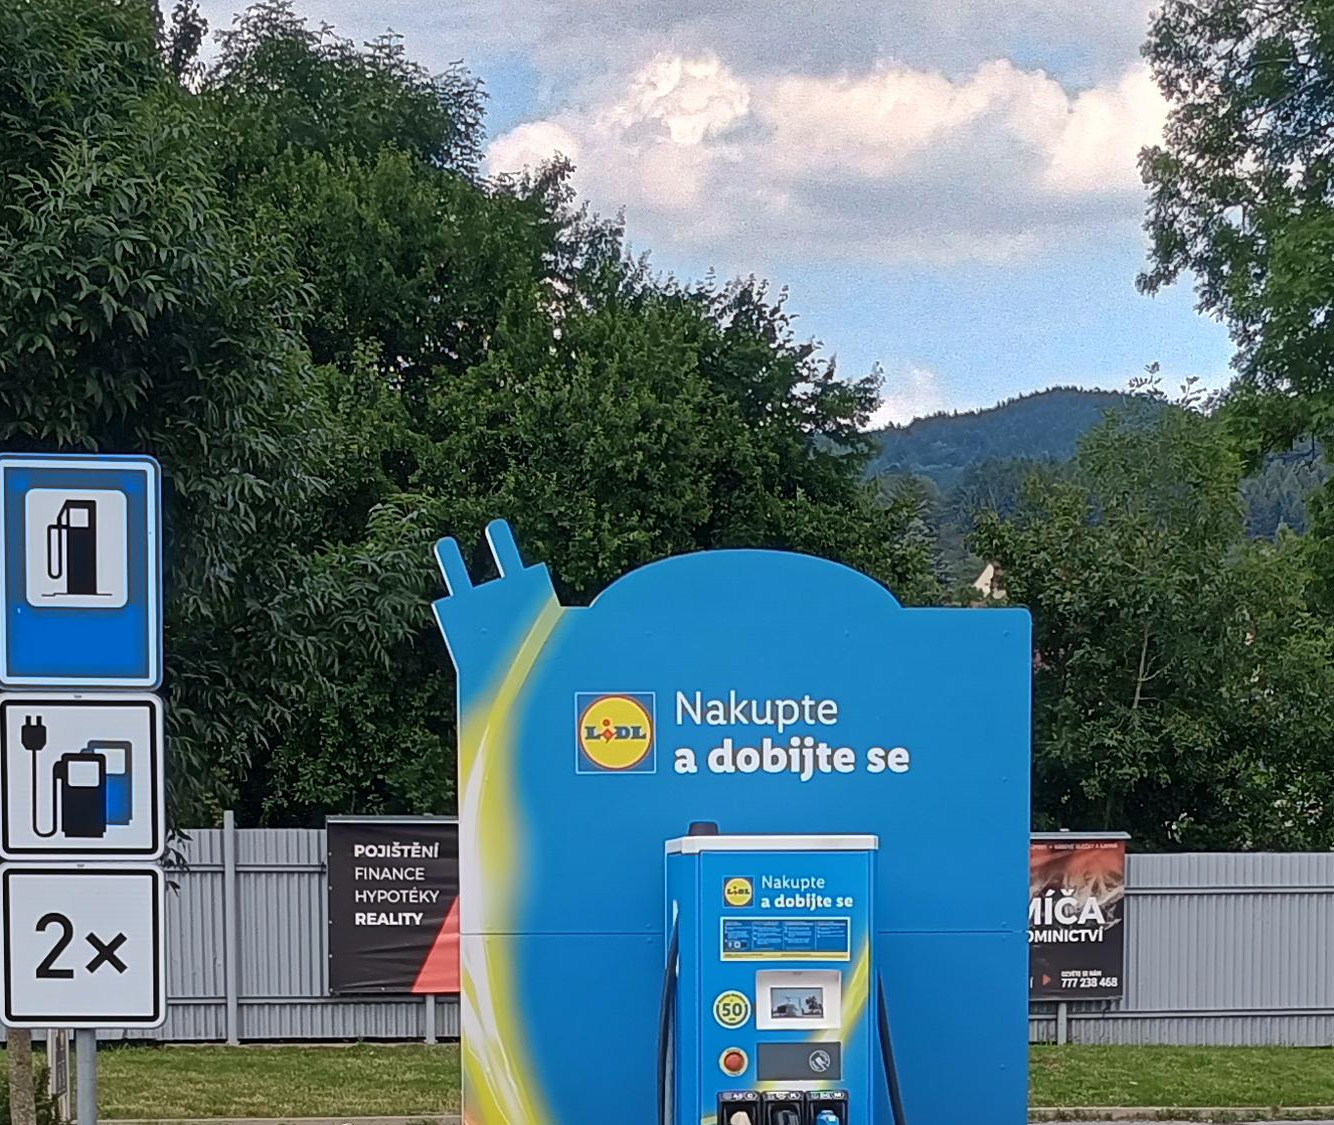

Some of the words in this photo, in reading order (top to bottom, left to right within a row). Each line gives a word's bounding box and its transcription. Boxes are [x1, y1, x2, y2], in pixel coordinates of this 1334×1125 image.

[675, 690, 839, 733] Nakupte
[673, 747, 698, 774] a
[707, 737, 856, 782] dobijte
[866, 746, 910, 774] se
[354, 842, 440, 858] POJIŠTĚNÍ
[355, 867, 425, 881] FINANCE
[761, 875, 826, 892] Nakupte
[355, 887, 440, 903] HYPOTÉKY
[760, 897, 771, 908] a
[774, 893, 832, 911] dobijte
[836, 896, 854, 908] se
[355, 912, 423, 926] REALITY
[1061, 977, 1078, 988] 777
[722, 1003, 742, 1017] 50
